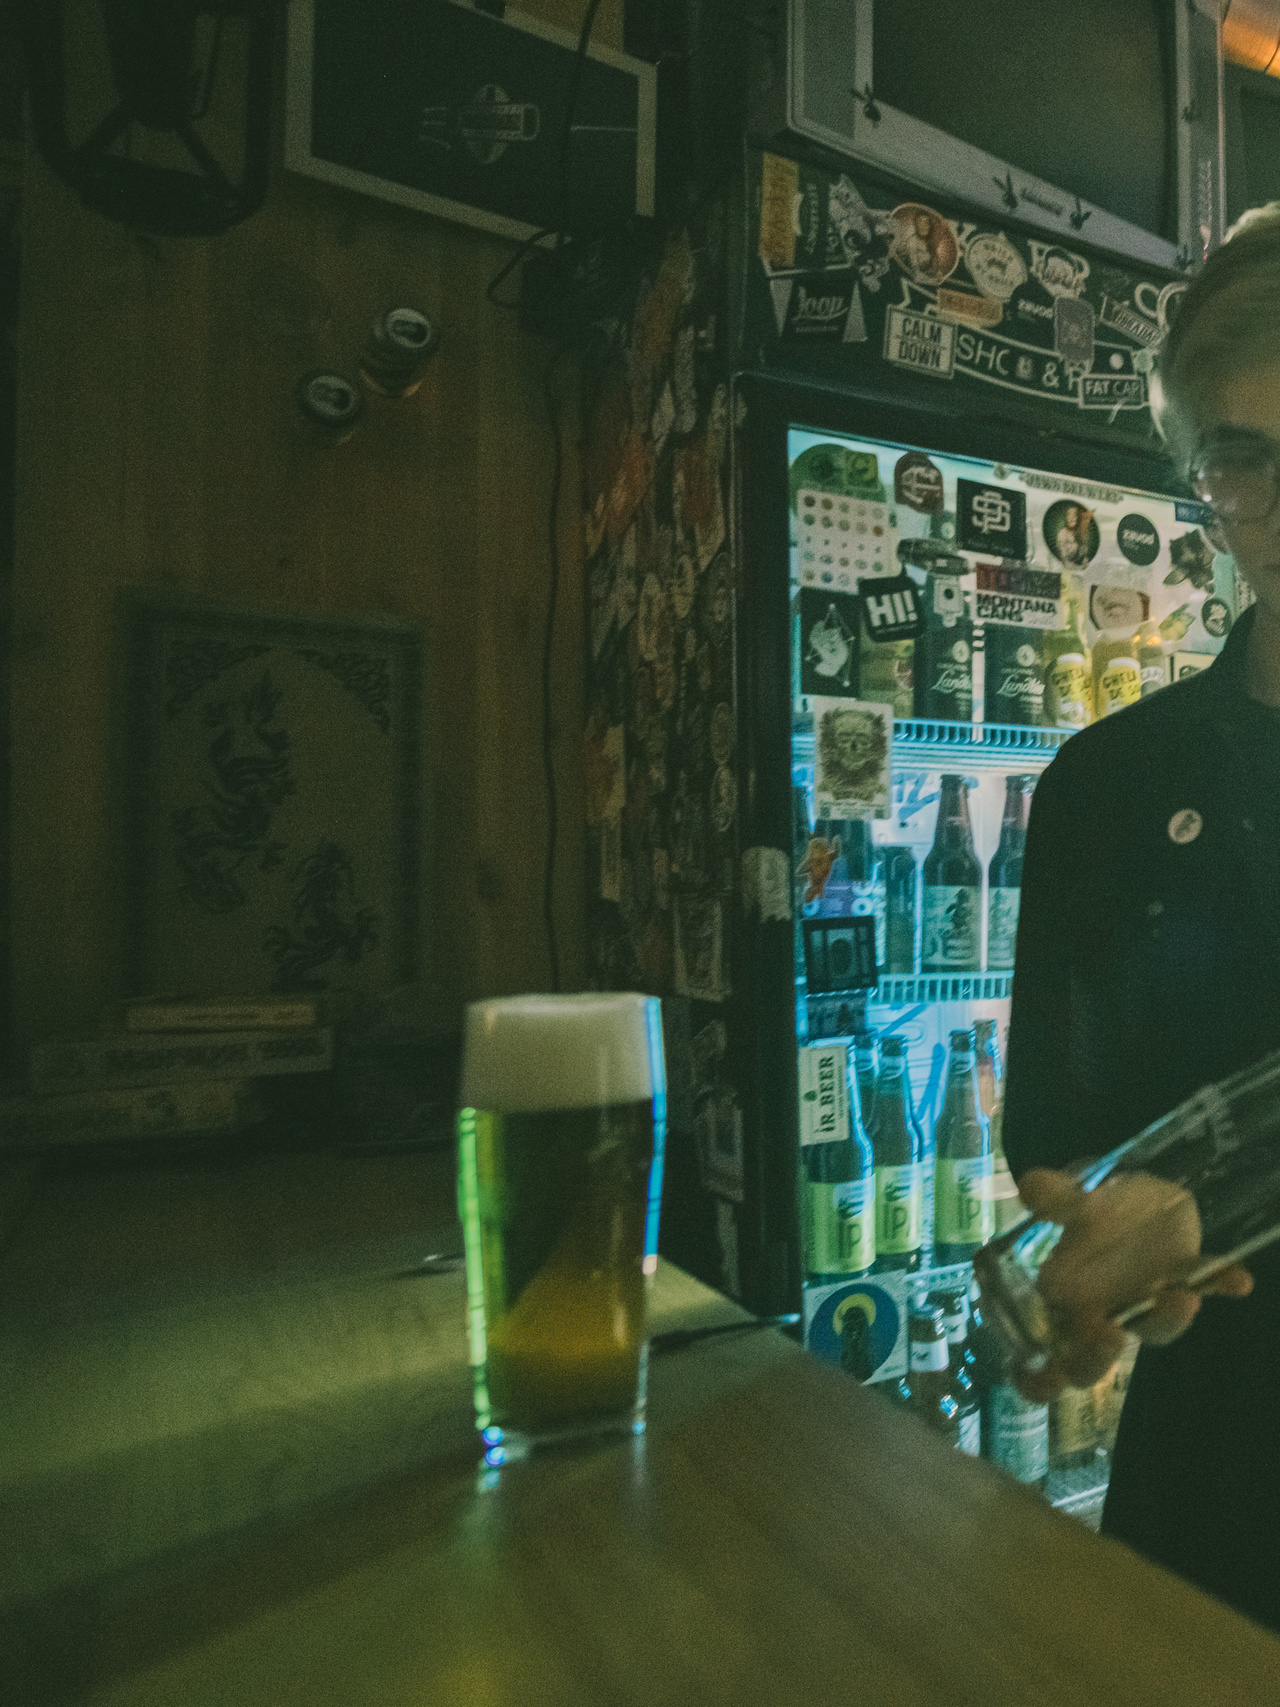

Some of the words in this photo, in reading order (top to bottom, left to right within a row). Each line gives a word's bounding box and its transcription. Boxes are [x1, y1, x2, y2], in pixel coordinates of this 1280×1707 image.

[902, 317, 942, 344] CALM
[898, 341, 941, 367] DOWN
[1085, 380, 1111, 396] FAT
[866, 590, 918, 627] HI!
[977, 593, 1057, 615] MONTANA
[977, 604, 1024, 622] CANS
